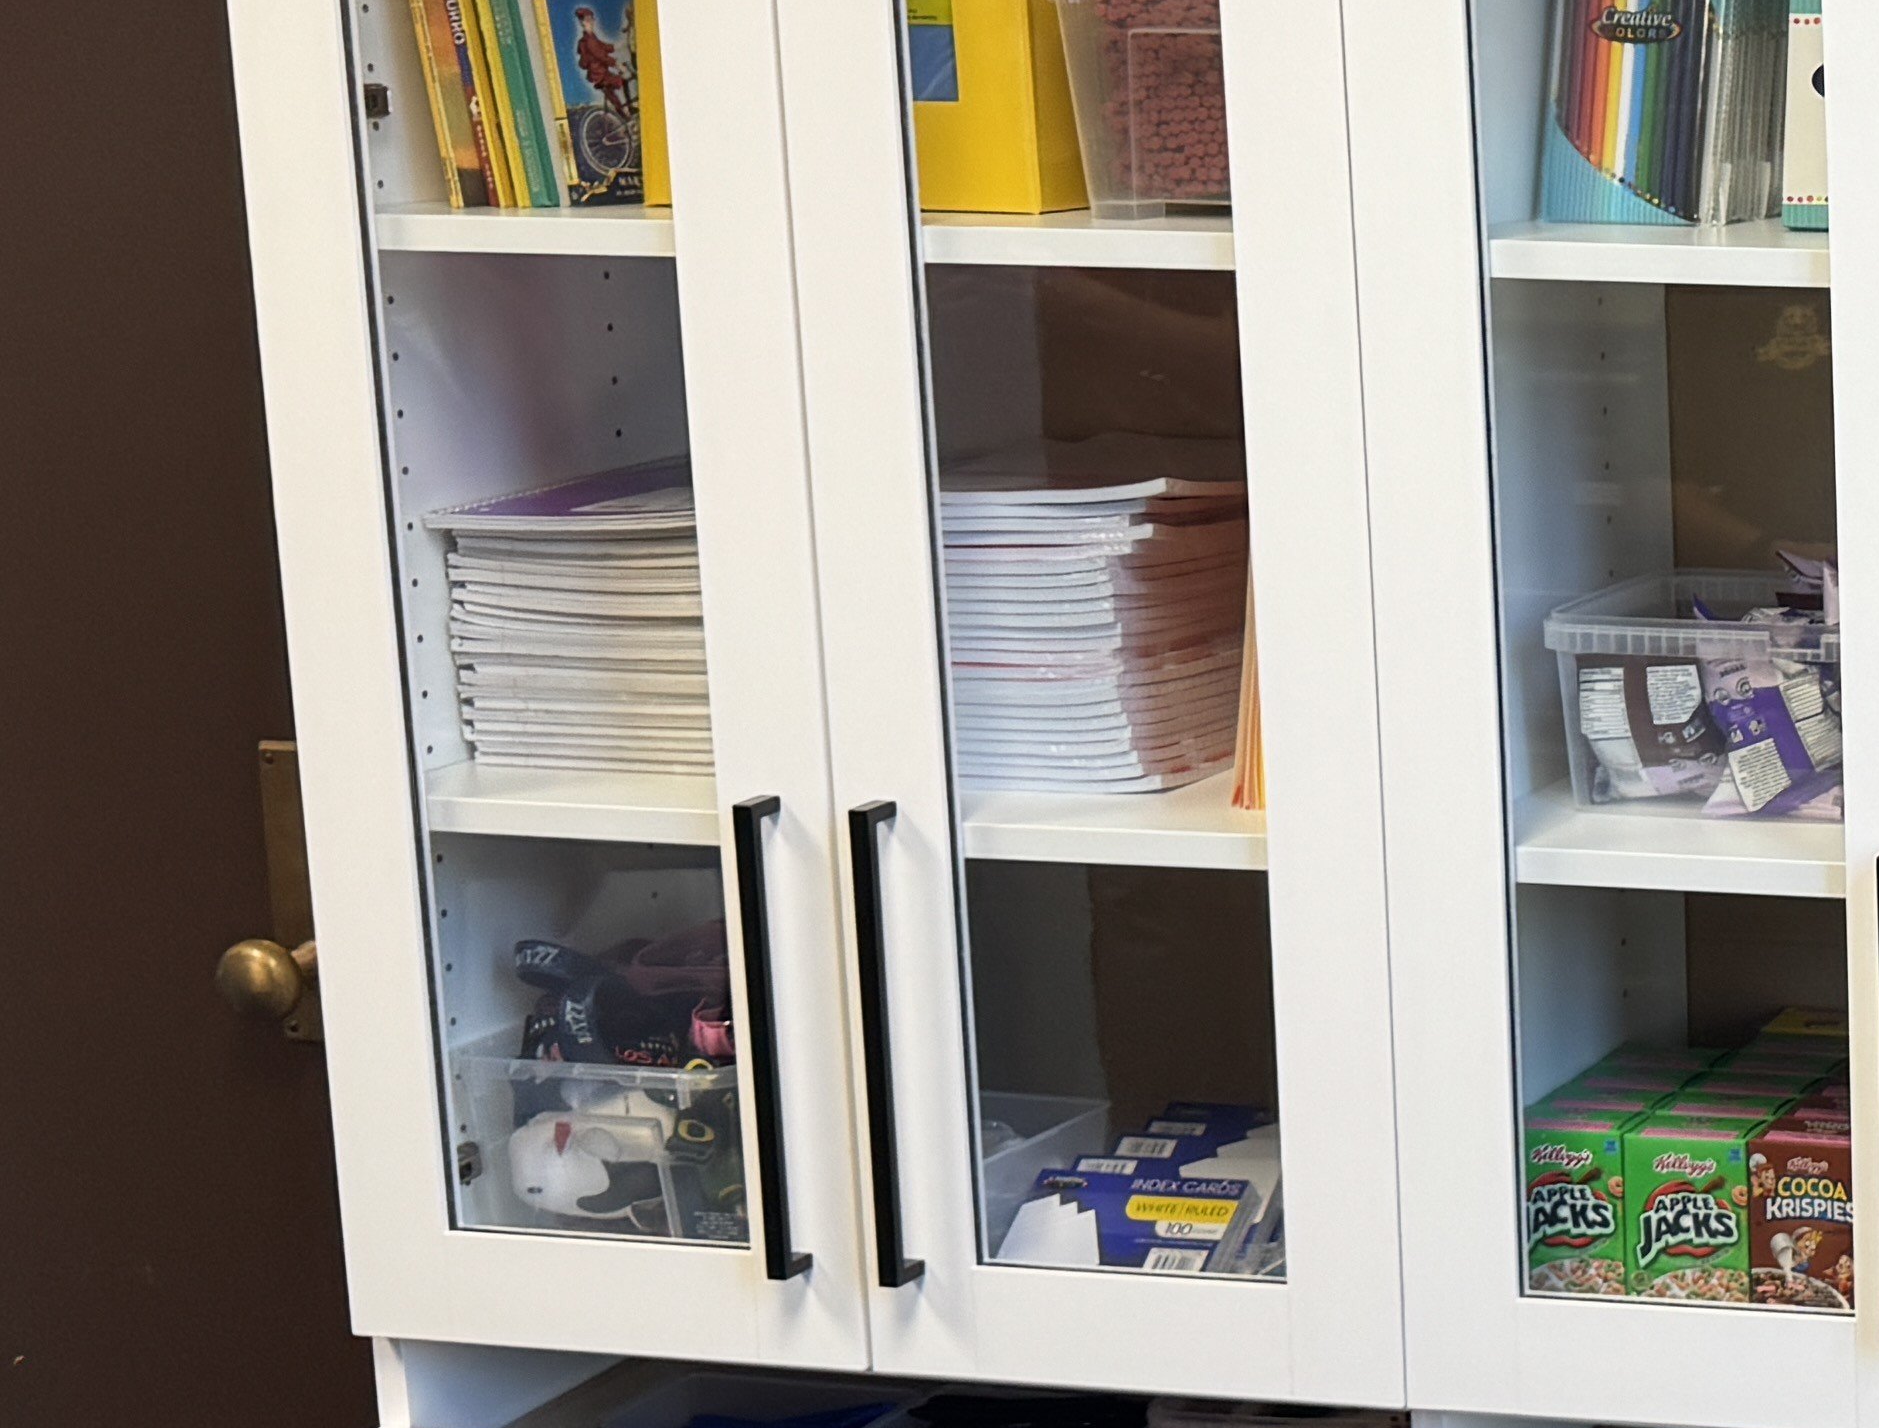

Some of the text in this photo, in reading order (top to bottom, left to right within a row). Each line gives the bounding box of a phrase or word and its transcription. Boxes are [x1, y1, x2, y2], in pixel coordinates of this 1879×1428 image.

[1601, 8, 1672, 27] Creative
[1131, 1178, 1243, 1195] INDEX CARDS
[1533, 1183, 1590, 1203] APPLE
[1778, 1177, 1847, 1201] COCOA
[1135, 1201, 1229, 1217] WHITE RULED
[1656, 1193, 1714, 1212] APPLE
[1766, 1197, 1853, 1222] KRISPIES
[1530, 1202, 1612, 1234] ACKS
[1165, 1222, 1193, 1235] 100
[1639, 1205, 1736, 1262] JACKS
